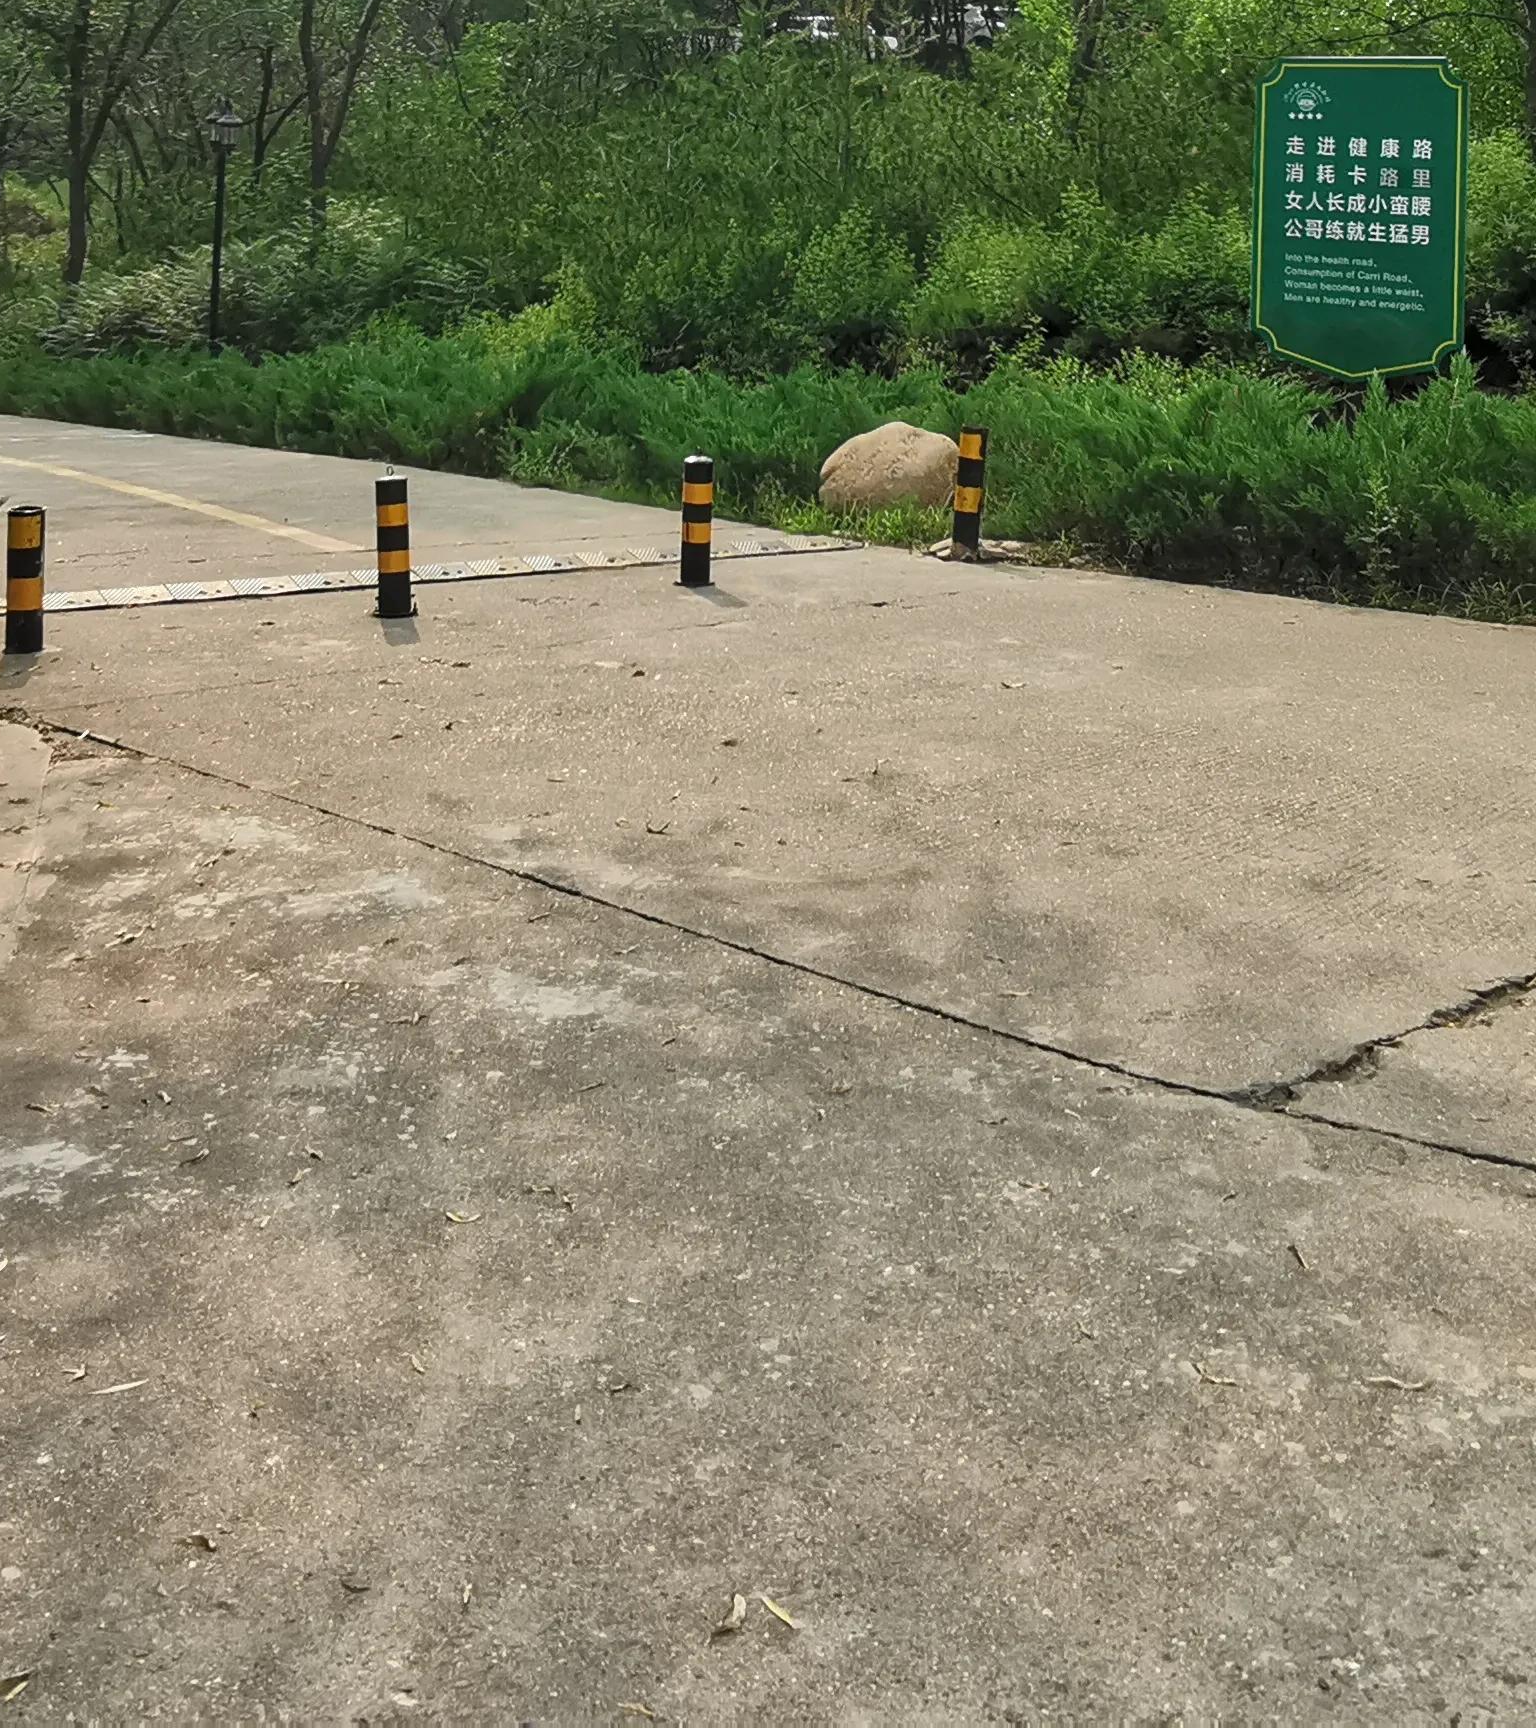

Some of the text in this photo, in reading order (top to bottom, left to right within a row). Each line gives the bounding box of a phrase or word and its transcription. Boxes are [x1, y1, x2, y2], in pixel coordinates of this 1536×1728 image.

[1286, 135, 1433, 160] 走进健康路
[1285, 162, 1431, 189] 消耗卡路里
[1285, 190, 1431, 217] 女人长成小蛮腰
[1284, 218, 1430, 246] 公哥练就生猛男
[1304, 254, 1320, 264] the
[1284, 266, 1343, 278] Consumption
[1345, 270, 1355, 279] of
[1284, 279, 1318, 290] Woman
[1320, 282, 1361, 293] becomes
[1363, 285, 1370, 293] a
[1284, 292, 1304, 302] Men
[1305, 295, 1321, 303] are
[1322, 295, 1357, 307] healthy
[1358, 298, 1377, 308] and
